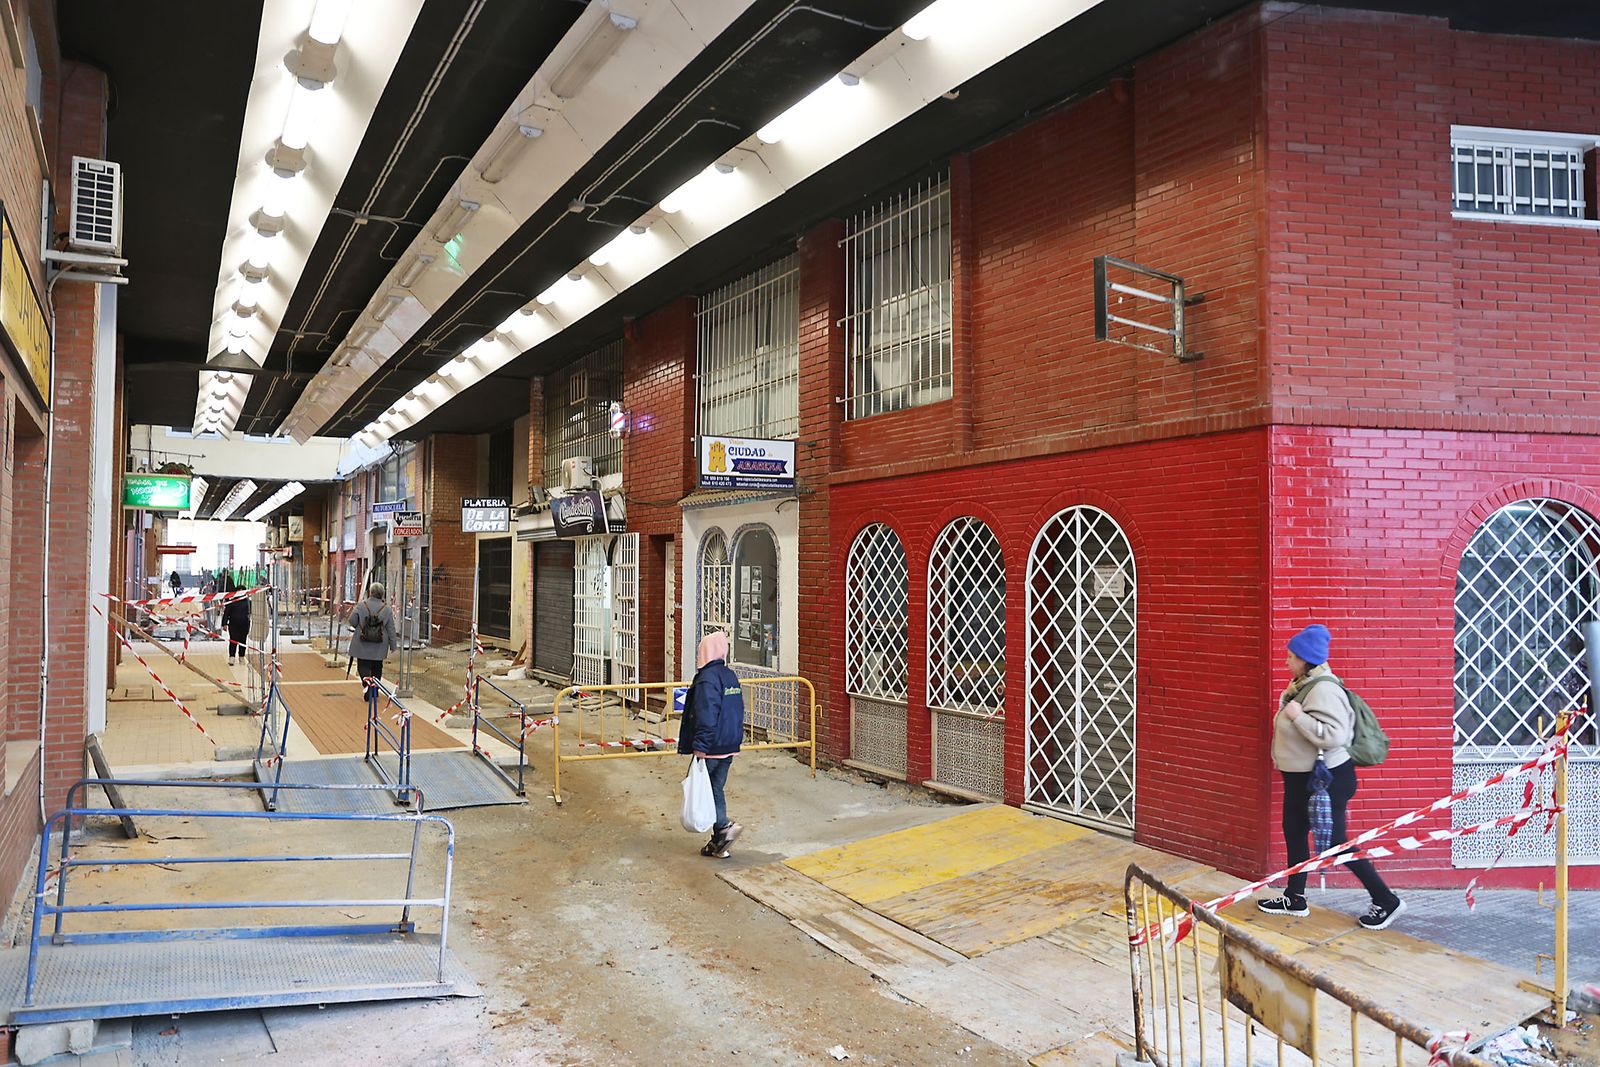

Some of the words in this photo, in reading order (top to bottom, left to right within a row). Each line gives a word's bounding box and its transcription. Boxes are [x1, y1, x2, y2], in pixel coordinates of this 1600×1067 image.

[728, 446, 766, 457] CIUDAD
[464, 499, 507, 507] PLATERIA
[467, 509, 484, 520] DE
[490, 510, 505, 520] LA
[466, 520, 506, 531] CORTE
